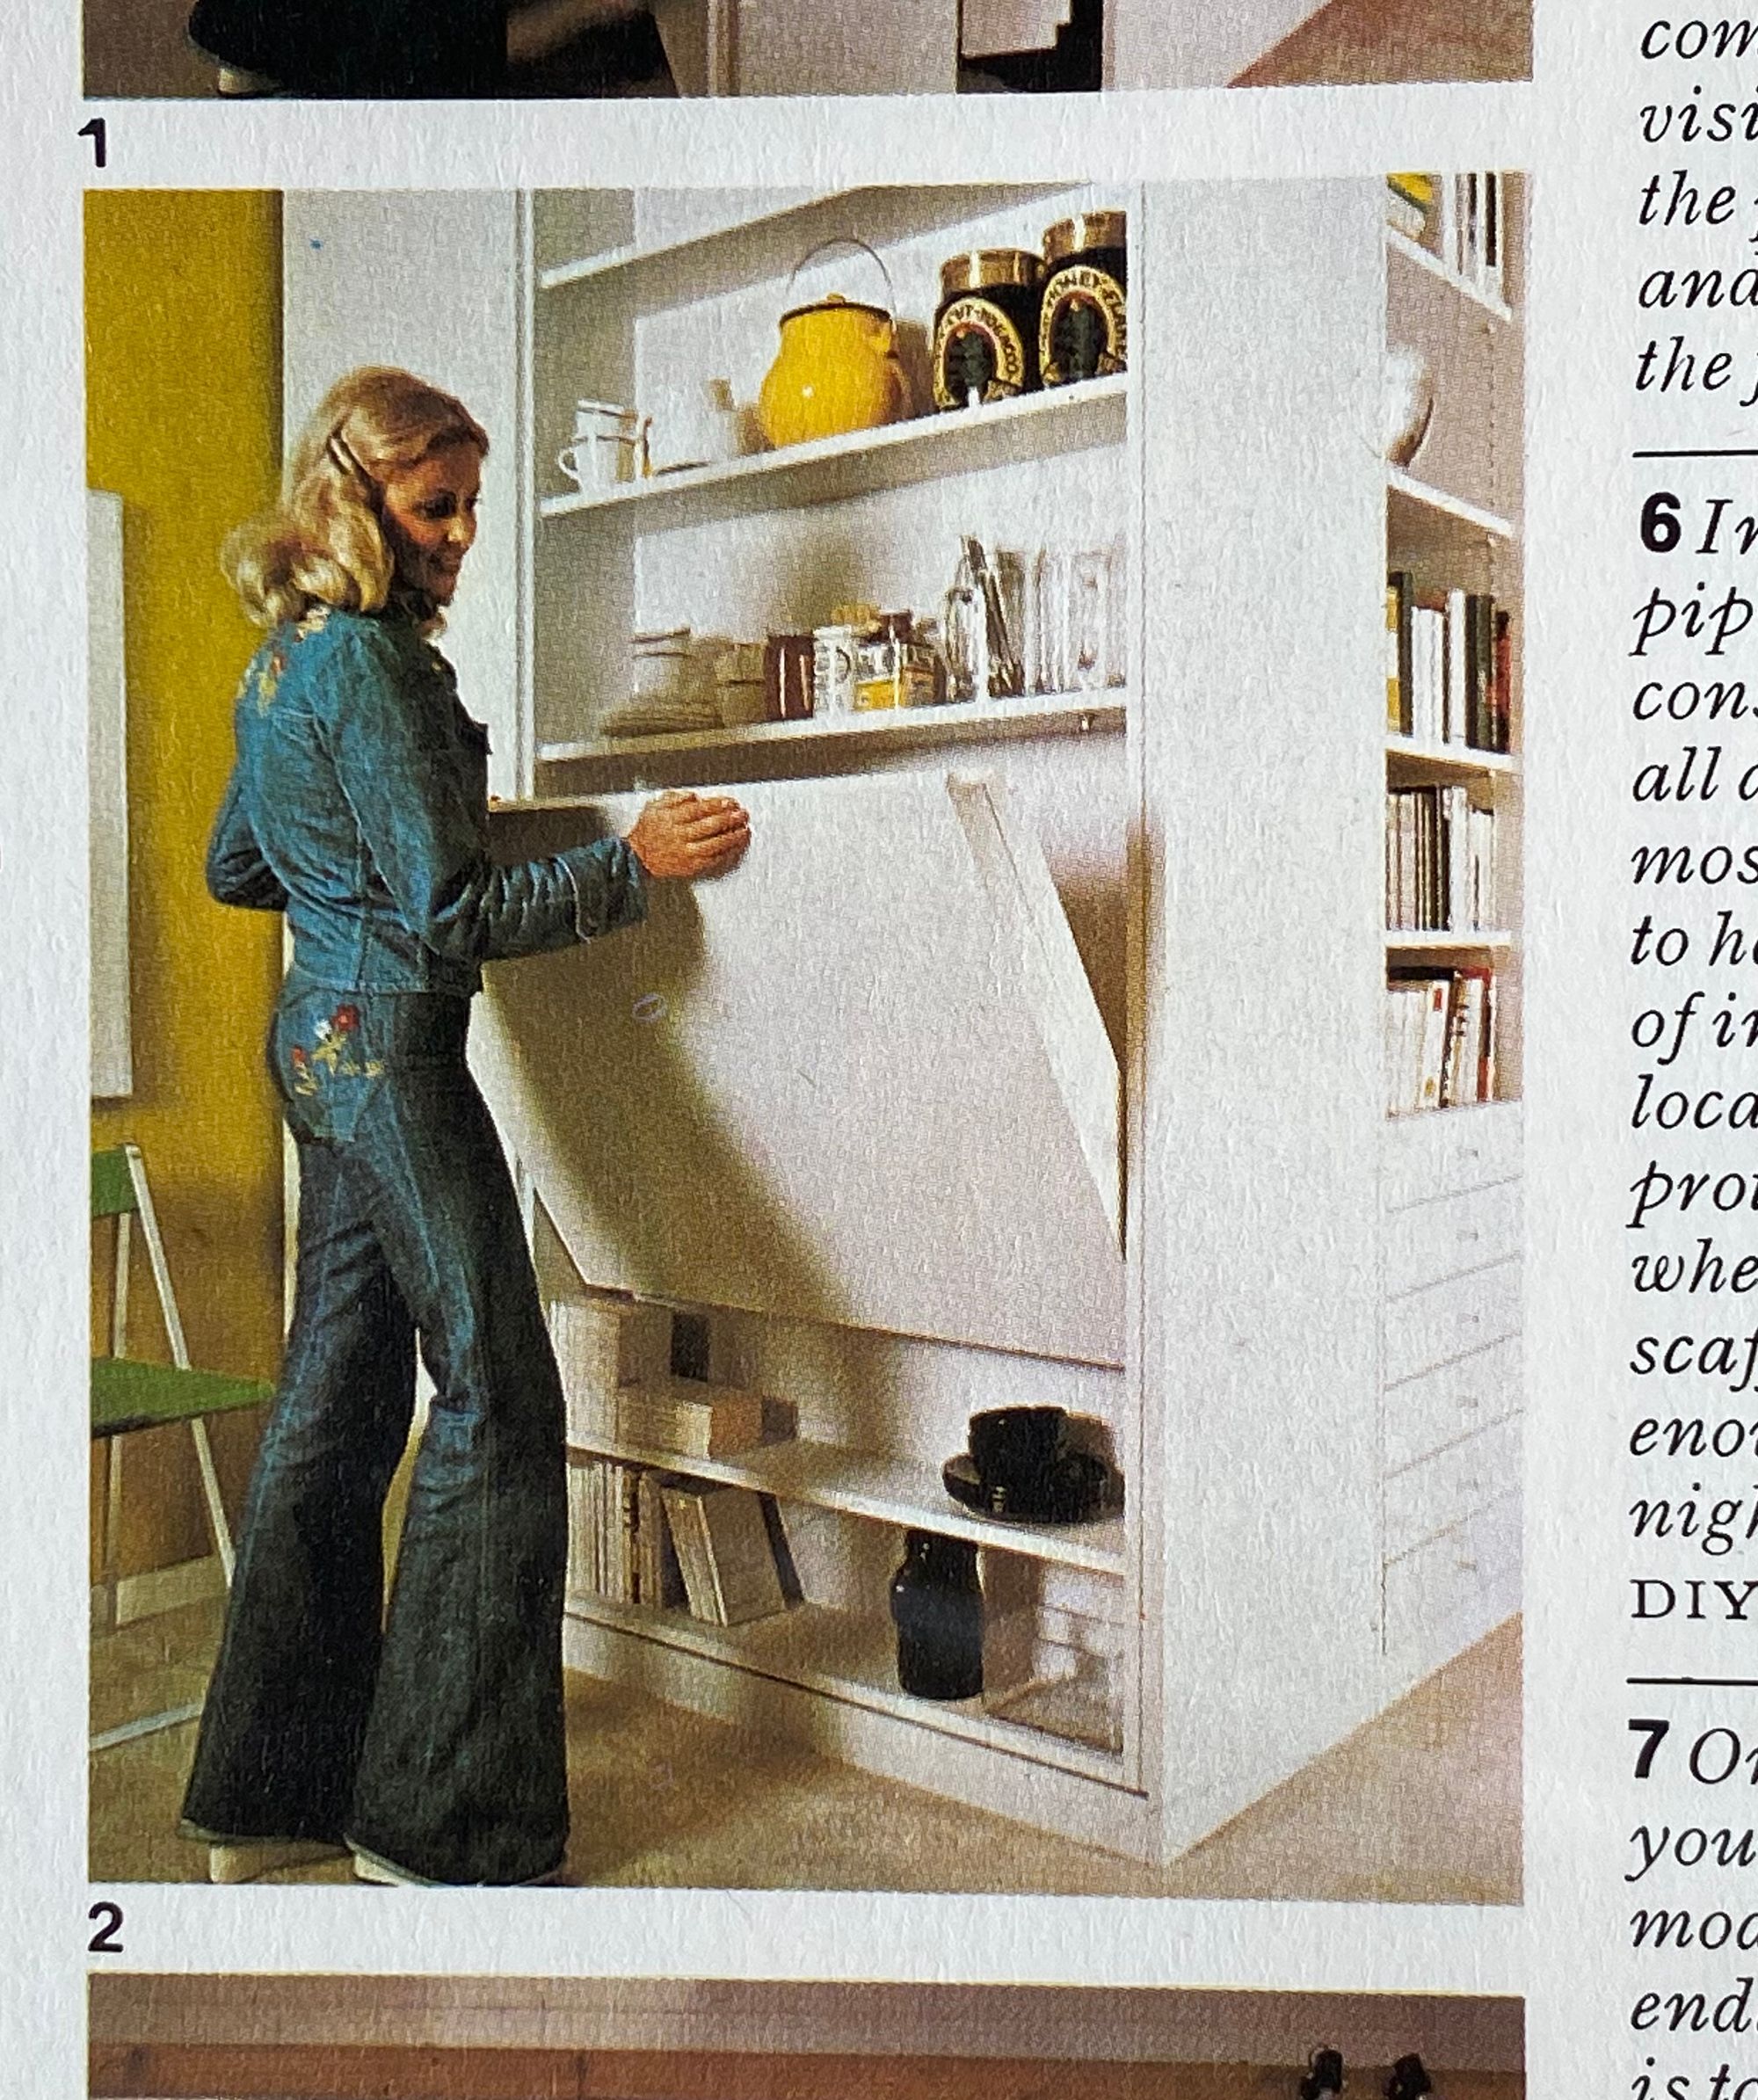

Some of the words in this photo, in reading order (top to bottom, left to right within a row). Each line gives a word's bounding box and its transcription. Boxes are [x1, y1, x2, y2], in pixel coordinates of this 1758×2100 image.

[78, 117, 106, 168] 1
[1638, 169, 1736, 226] the
[1635, 335, 1733, 393] the
[1640, 491, 1682, 553] 6
[1628, 581, 1754, 657] pip
[1632, 745, 1722, 802] all
[1631, 915, 1689, 967] to
[1709, 910, 1758, 967] h
[1631, 991, 1705, 1066] of
[1625, 1159, 1758, 1229] pro
[1631, 1237, 1758, 1294] whe
[1630, 1418, 1758, 1457] eno
[1630, 1579, 1758, 1621] DIY
[1628, 1719, 1670, 1779] 7
[1624, 1826, 1756, 1882] you
[88, 1901, 124, 1953] 2
